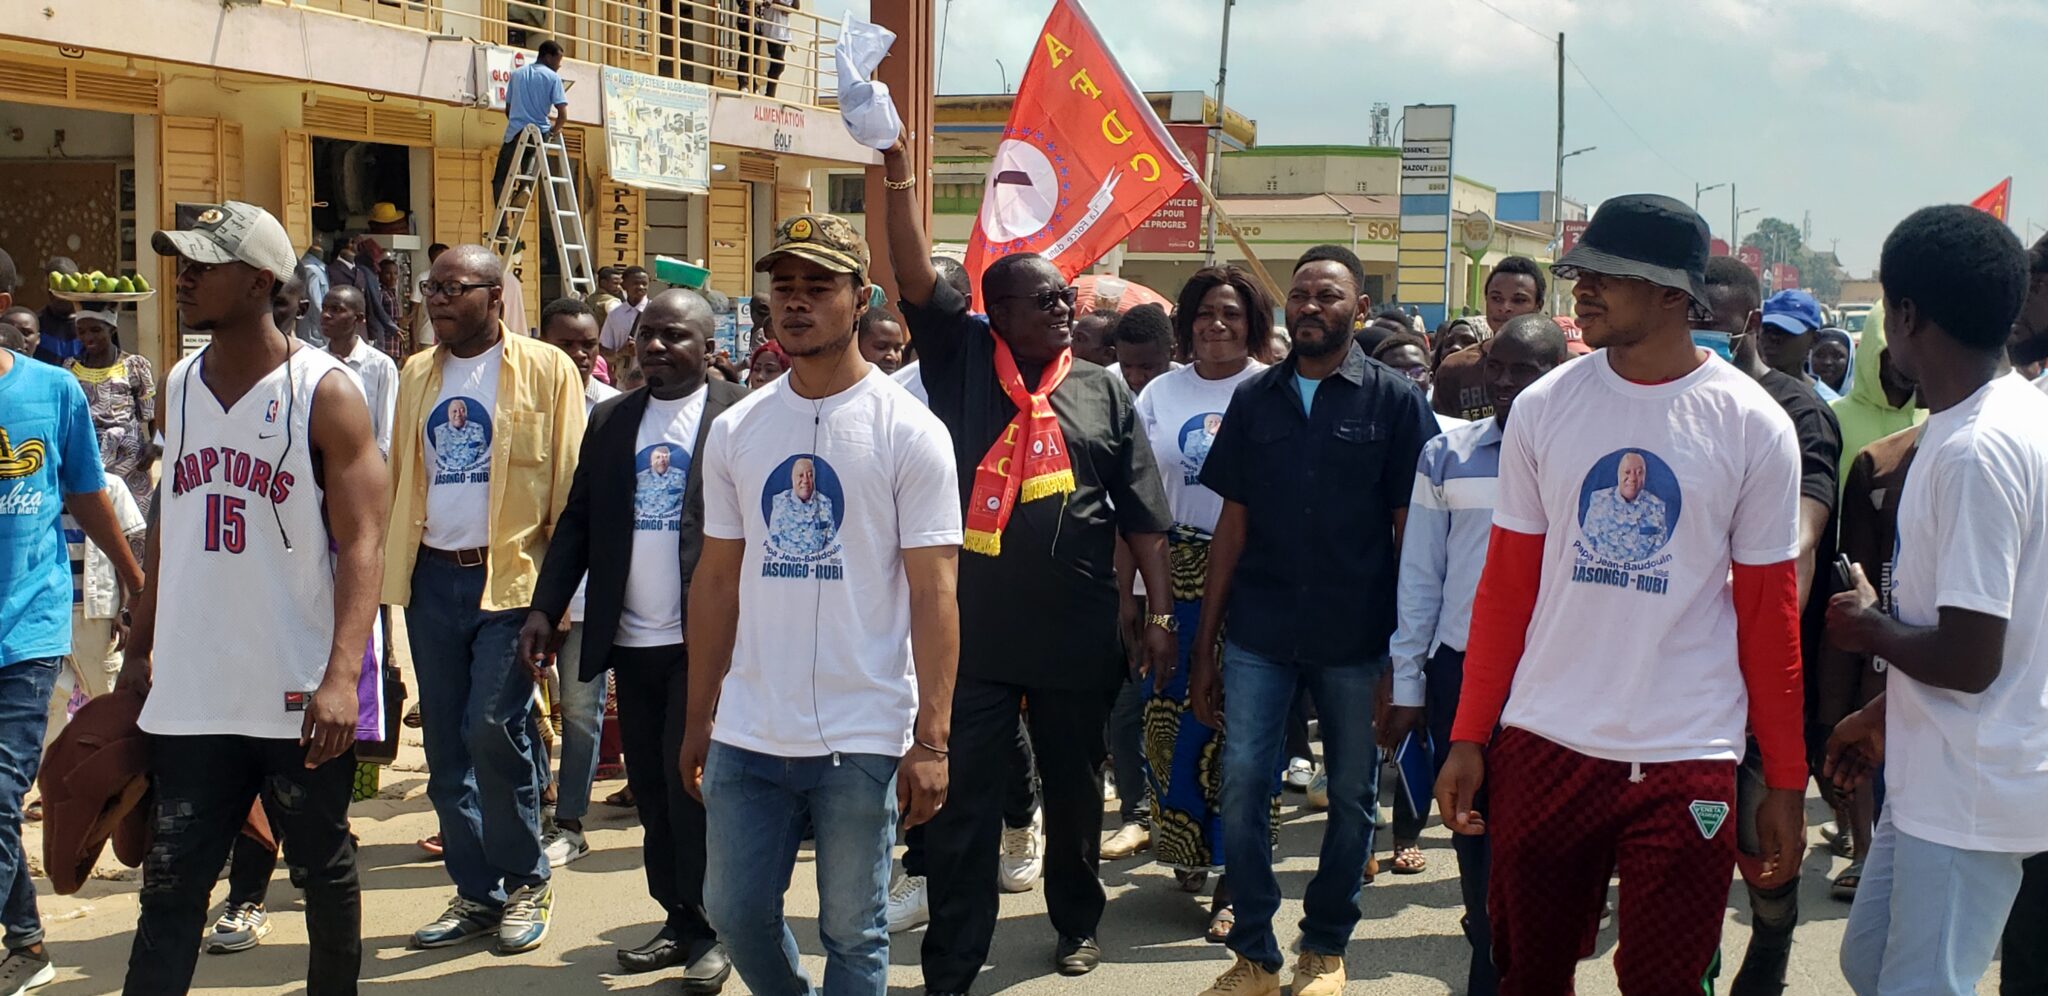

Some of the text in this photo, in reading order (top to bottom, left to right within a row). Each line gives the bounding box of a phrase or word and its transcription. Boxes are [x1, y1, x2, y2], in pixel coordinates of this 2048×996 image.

[498, 87, 506, 101] B
[754, 105, 805, 128] ALIMENTATION
[774, 132, 792, 149] GOLF
[1187, 199, 1198, 207] DE
[1151, 221, 1187, 229] PROGRES
[173, 446, 296, 504] RAPTORS
[204, 493, 248, 554] 15
[1573, 540, 1673, 572] Papa Jean-Baudouin
